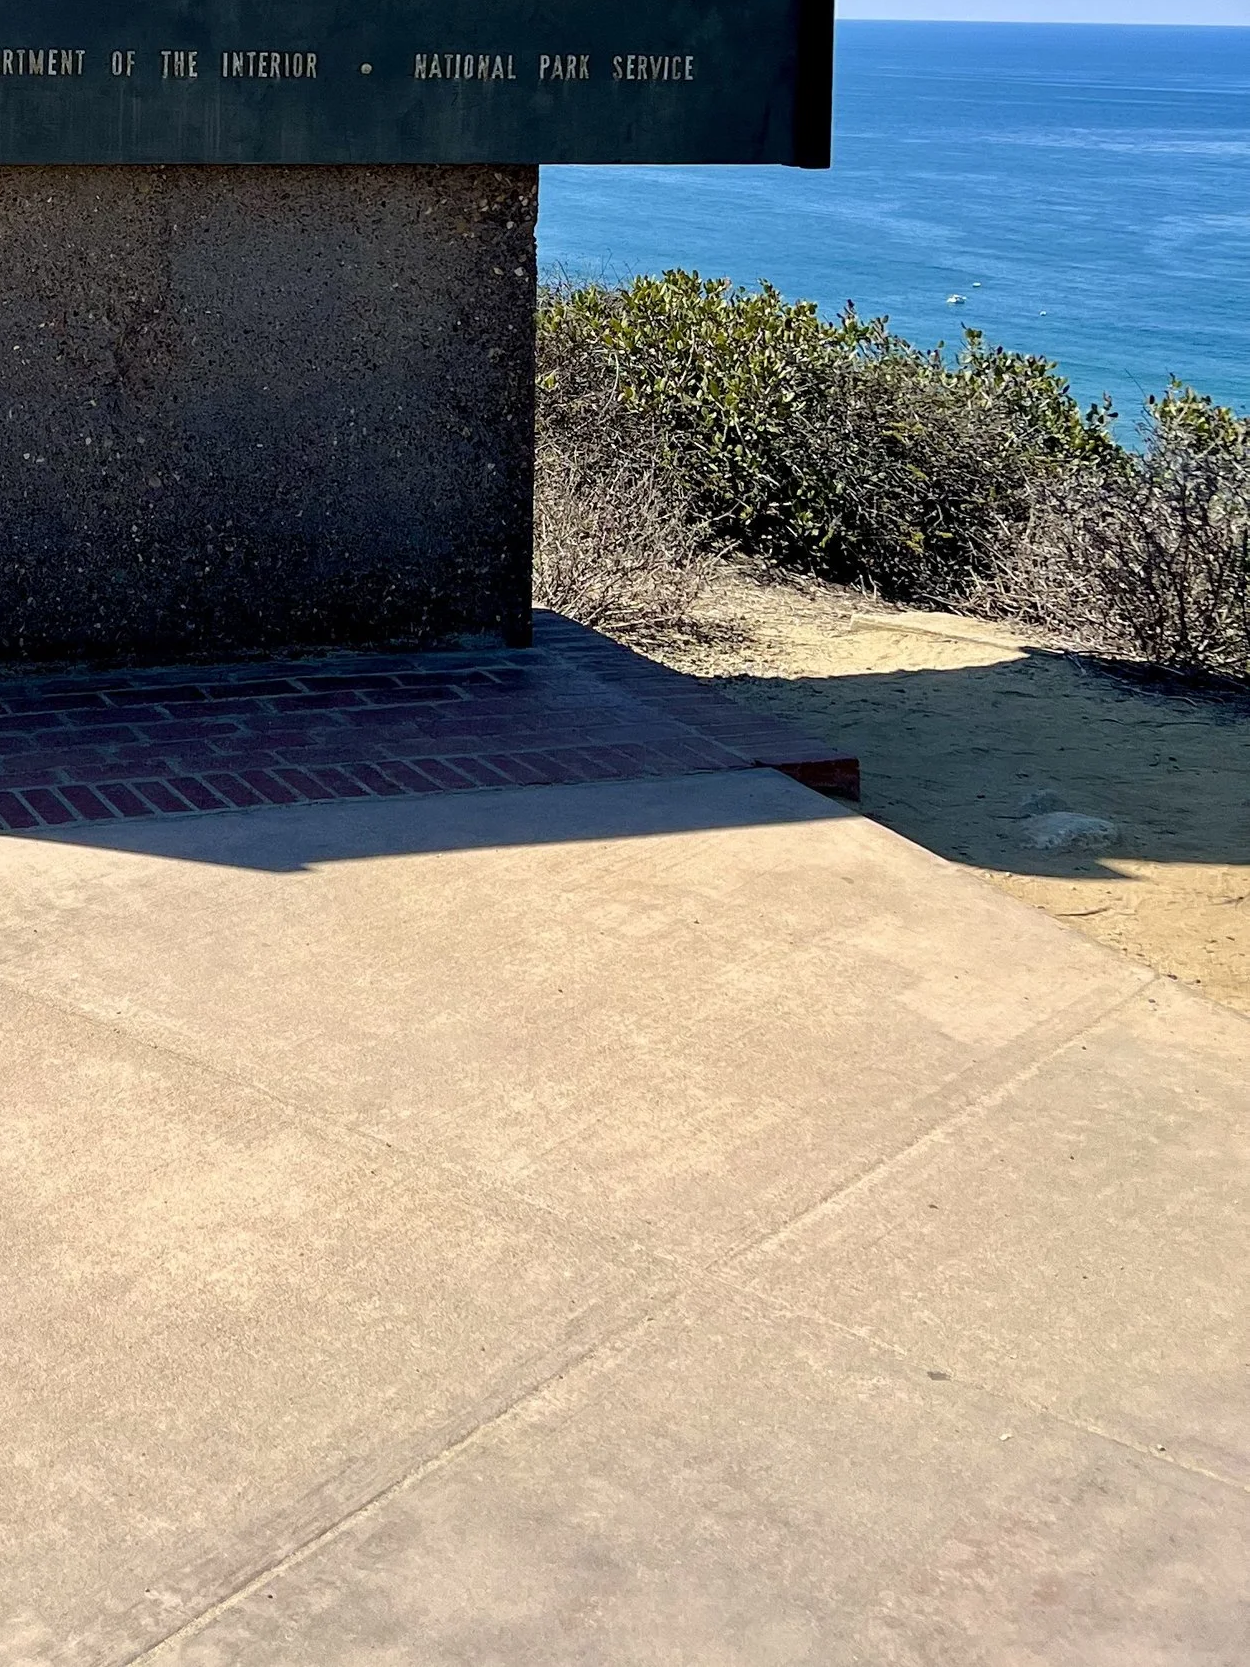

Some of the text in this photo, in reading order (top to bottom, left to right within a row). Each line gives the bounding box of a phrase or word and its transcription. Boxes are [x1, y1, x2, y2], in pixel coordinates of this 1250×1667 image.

[111, 50, 136, 77] OF
[161, 50, 198, 78] THE
[222, 51, 318, 79] INTERIOR
[414, 53, 516, 80] NATIONAL
[540, 54, 590, 80] PARK
[613, 55, 694, 81] SERVICE
